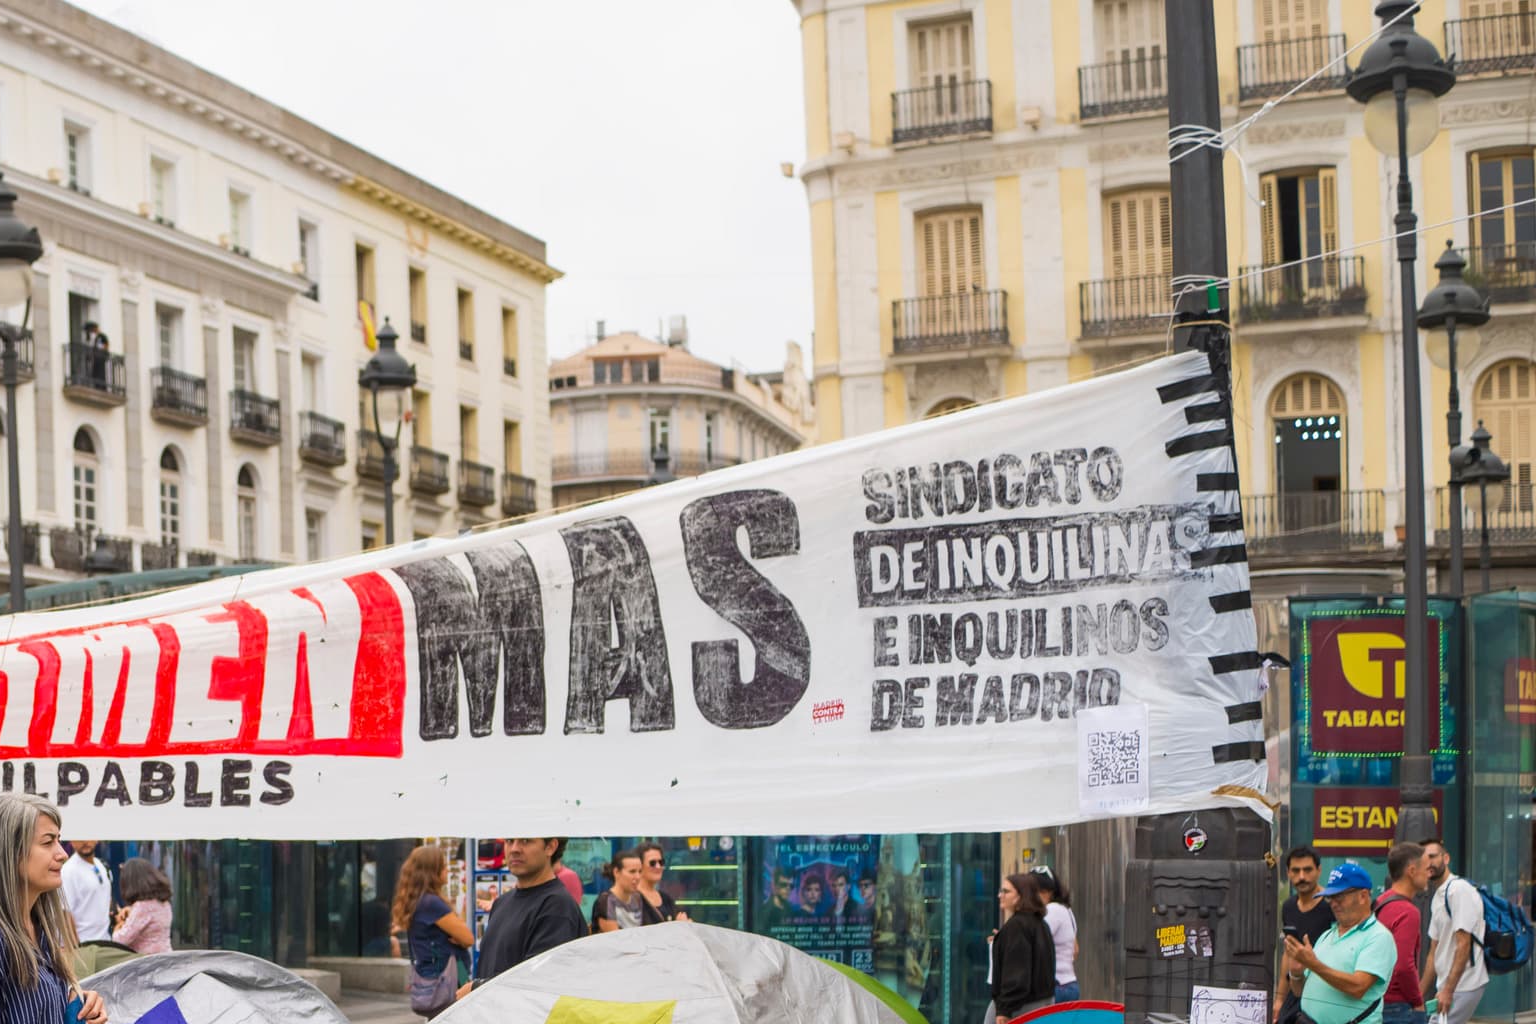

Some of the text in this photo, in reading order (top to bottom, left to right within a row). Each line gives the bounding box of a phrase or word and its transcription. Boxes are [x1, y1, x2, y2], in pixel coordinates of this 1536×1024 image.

[870, 518, 1208, 594] DE INQUILINAS
[393, 488, 812, 742] MAS
[872, 597, 1170, 668] E INQUILINOS
[813, 705, 844, 718] CONTRA
[870, 667, 1121, 732] DE MADRID
[1323, 710, 1406, 728] TABAC
[1320, 806, 1438, 829] ESTAN
[855, 953, 872, 962] 23
